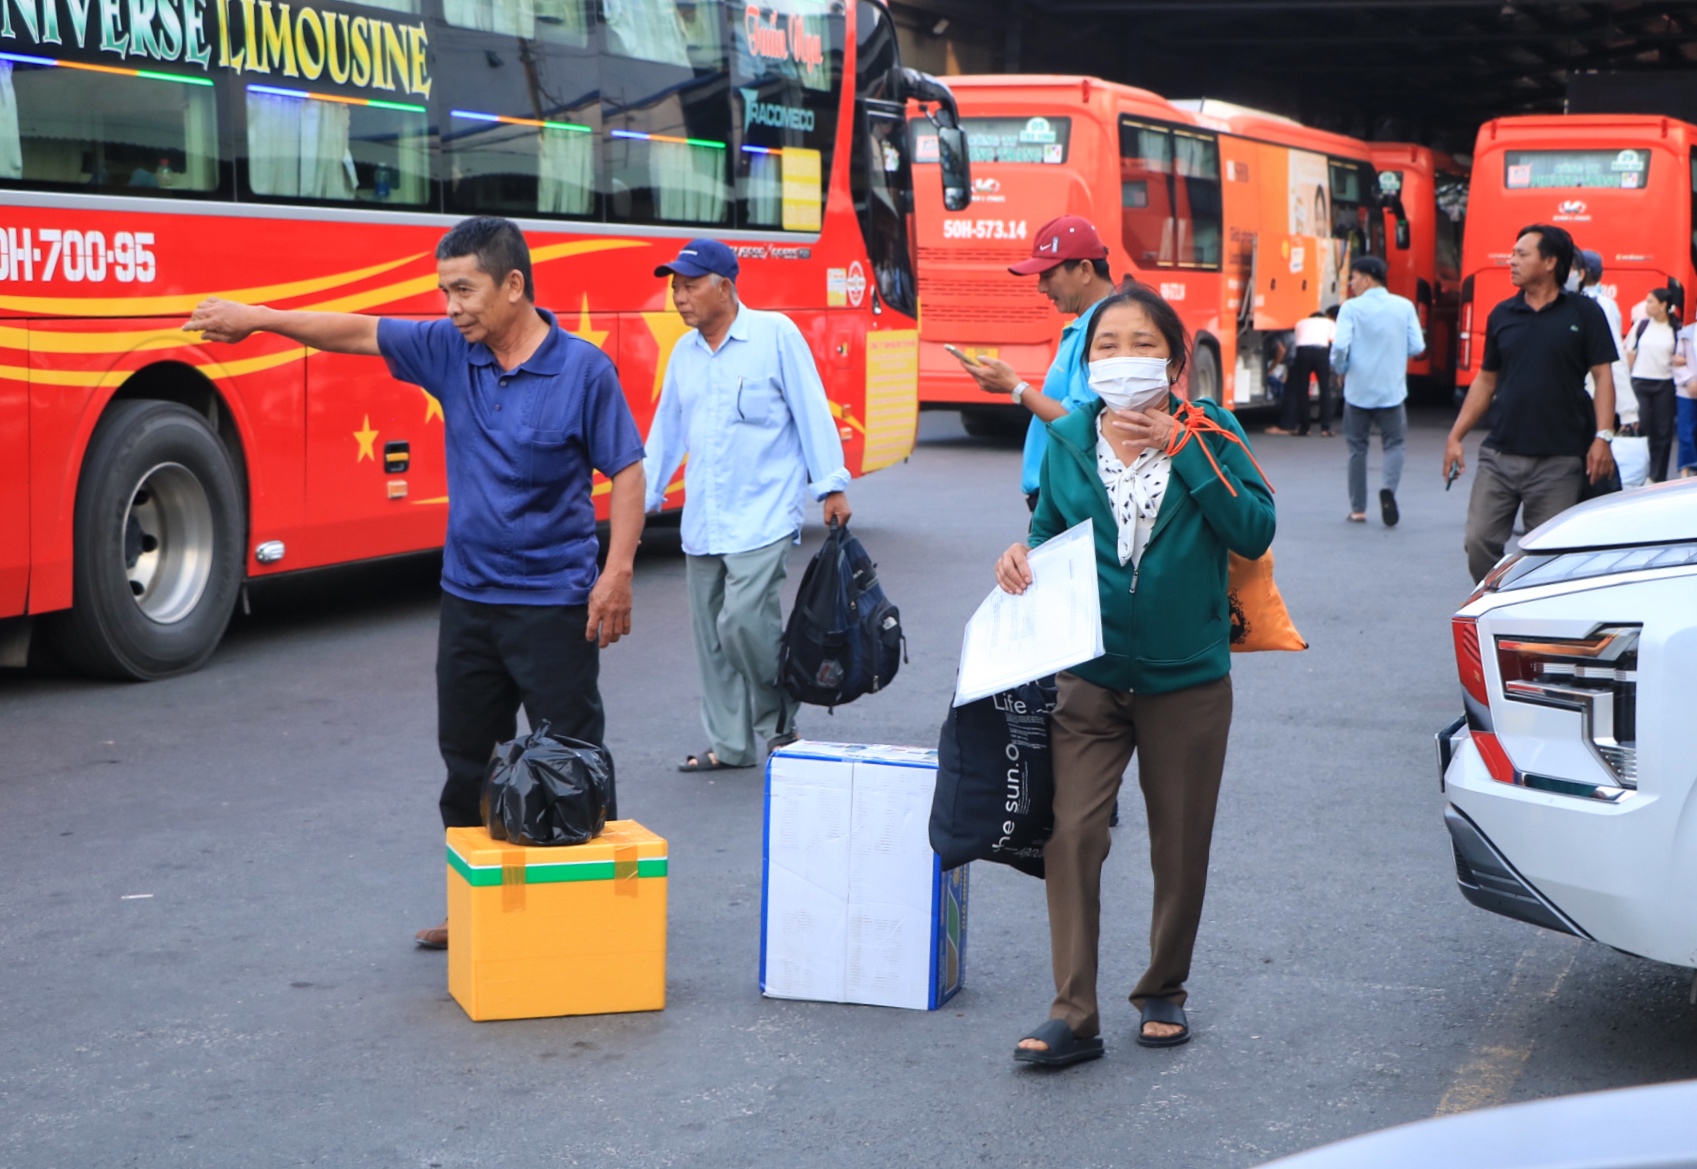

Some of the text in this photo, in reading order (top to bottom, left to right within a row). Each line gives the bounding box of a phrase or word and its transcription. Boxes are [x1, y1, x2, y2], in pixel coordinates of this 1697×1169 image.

[218, 0, 432, 100] LIMOUSINE
[739, 88, 815, 134] TRACOMECO
[943, 219, 1027, 239] 50H-573.14
[993, 691, 1027, 714] Life
